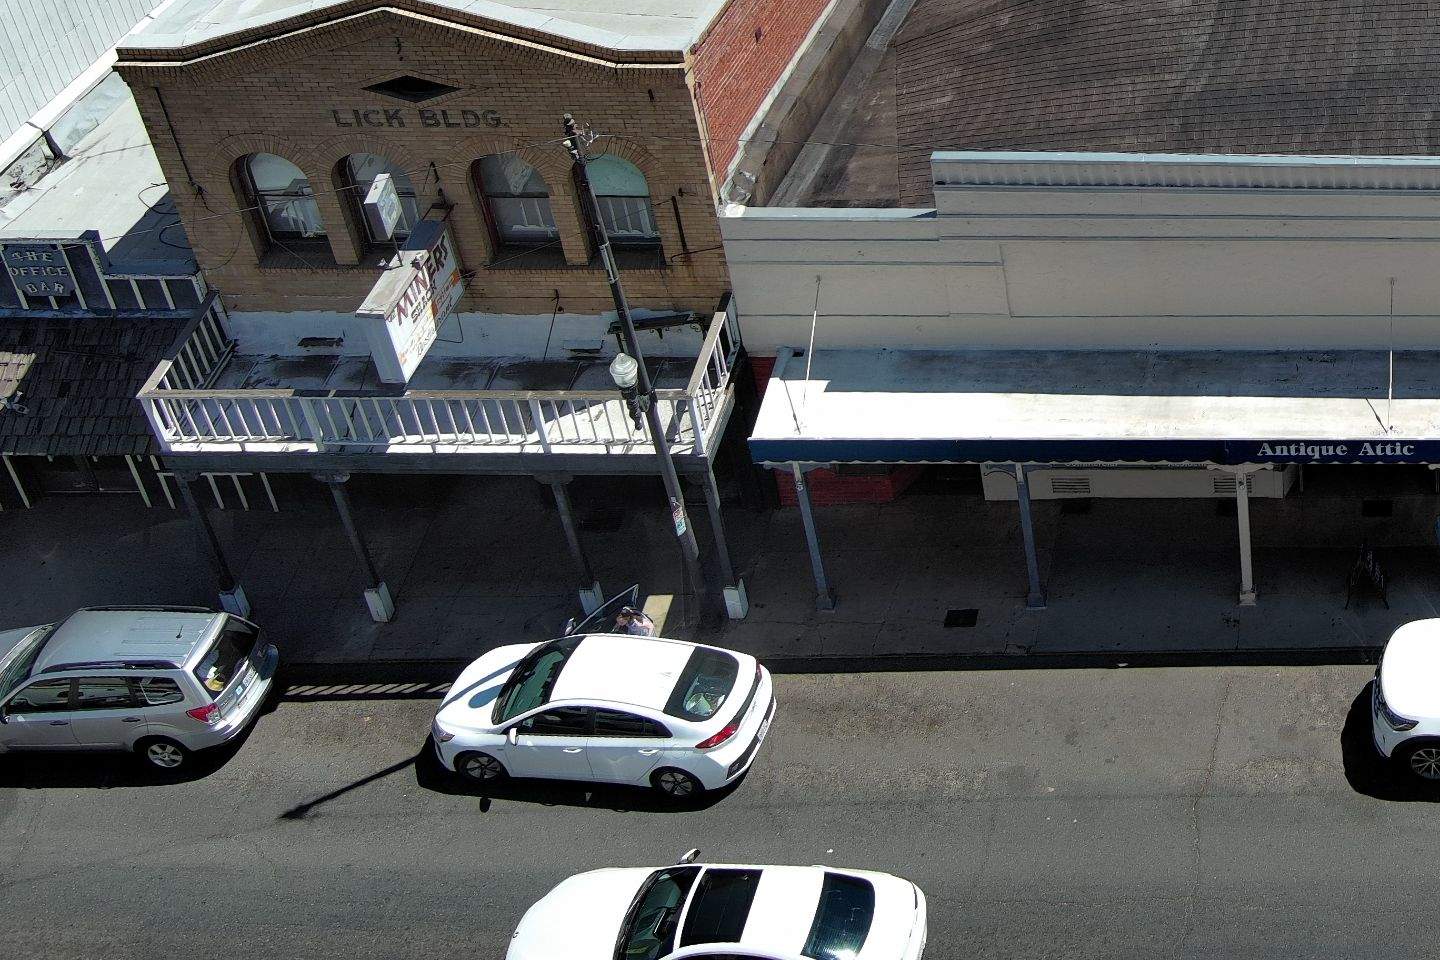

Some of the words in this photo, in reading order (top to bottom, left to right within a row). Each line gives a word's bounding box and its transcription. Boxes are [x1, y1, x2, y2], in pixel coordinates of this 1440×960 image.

[332, 109, 405, 128] LICK
[10, 266, 68, 276] OFFICE
[25, 281, 64, 294] BAR
[1257, 442, 1348, 459] Antique
[1358, 442, 1415, 456] Attic
